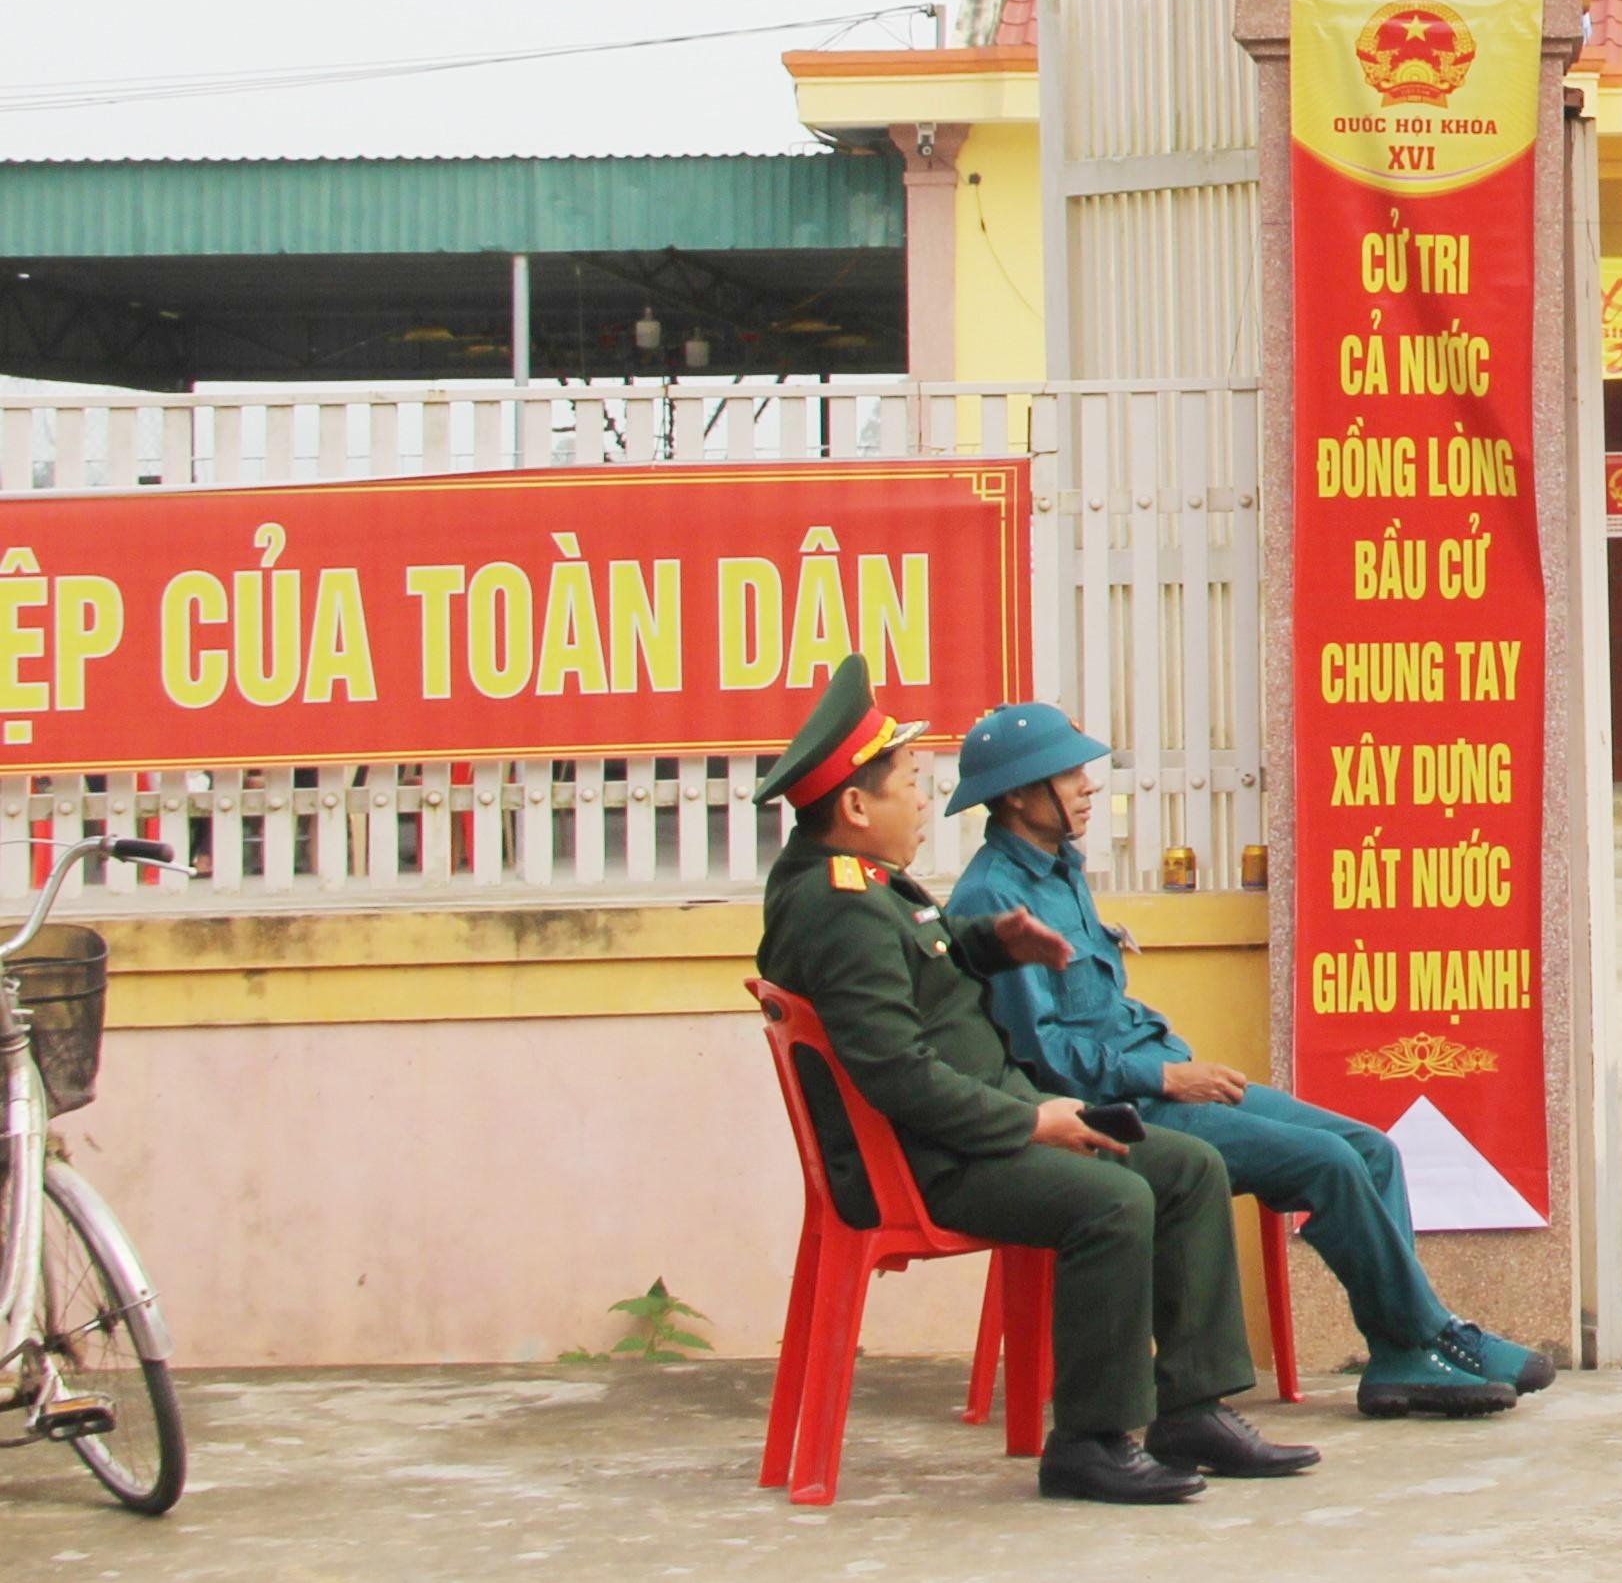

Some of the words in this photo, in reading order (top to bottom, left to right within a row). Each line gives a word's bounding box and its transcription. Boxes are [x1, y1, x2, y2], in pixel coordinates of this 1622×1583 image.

[1333, 115, 1387, 134] QUỐC
[1395, 117, 1432, 135] HỘI
[1440, 118, 1498, 136] KHÓA
[1387, 144, 1437, 172] XVI
[1361, 208, 1410, 294] CỬ
[1415, 234, 1470, 295] TRI
[1340, 308, 1389, 396] CẢ
[1399, 318, 1490, 397] NƯỚC
[1316, 416, 1417, 499] ĐỒNG
[1428, 421, 1517, 498] LÒNG
[1354, 518, 1427, 601] BẦU
[1438, 512, 1492, 600] CỬ
[160, 522, 378, 709] CỦA
[405, 530, 683, 701] TOÀN
[716, 524, 931, 692] DÂN
[1321, 640, 1445, 704] CHUNG
[1454, 640, 1522, 702] TAY
[1330, 732, 1402, 807] XÂY
[1412, 737, 1512, 818] DỰNG
[1331, 826, 1402, 910] ĐẤT
[1412, 828, 1511, 909] NƯỚC
[1312, 938, 1397, 1015] GIÀU
[1409, 949, 1531, 1025] MẠNH!
